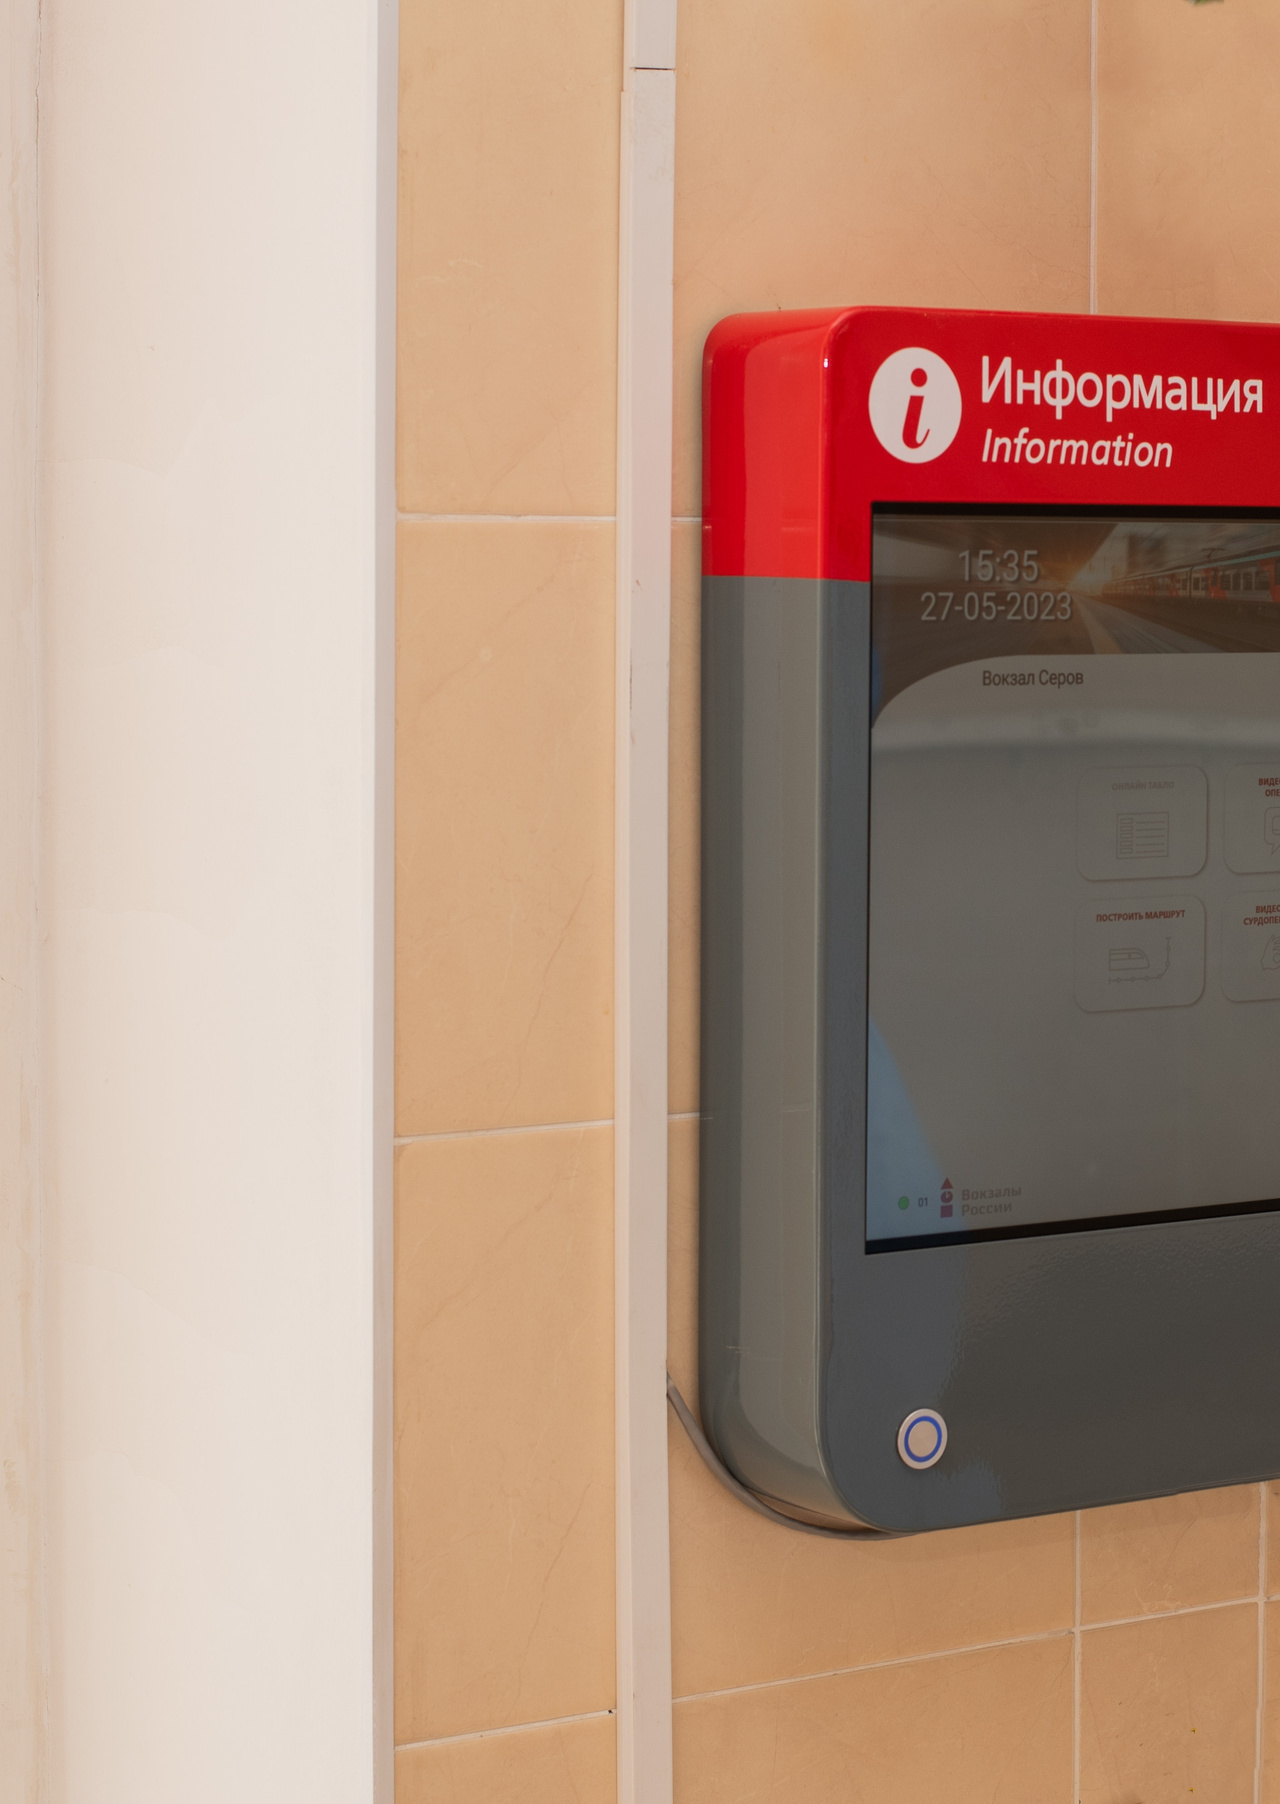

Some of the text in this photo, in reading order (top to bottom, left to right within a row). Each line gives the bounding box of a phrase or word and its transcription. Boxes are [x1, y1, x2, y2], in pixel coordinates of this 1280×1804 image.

[981, 355, 1264, 422] Информация
[981, 428, 1173, 468] Information
[959, 549, 1039, 582] 15:35
[920, 592, 1072, 621] 27-05-2023
[982, 669, 1084, 688] Вокзал Серов
[1149, 780, 1175, 790] ТАБЛО
[1096, 909, 1186, 923] ПОСТРОИТЬ МАРШРУТ
[961, 1187, 1022, 1201] Вокзалы
[961, 1203, 1012, 1217] России
